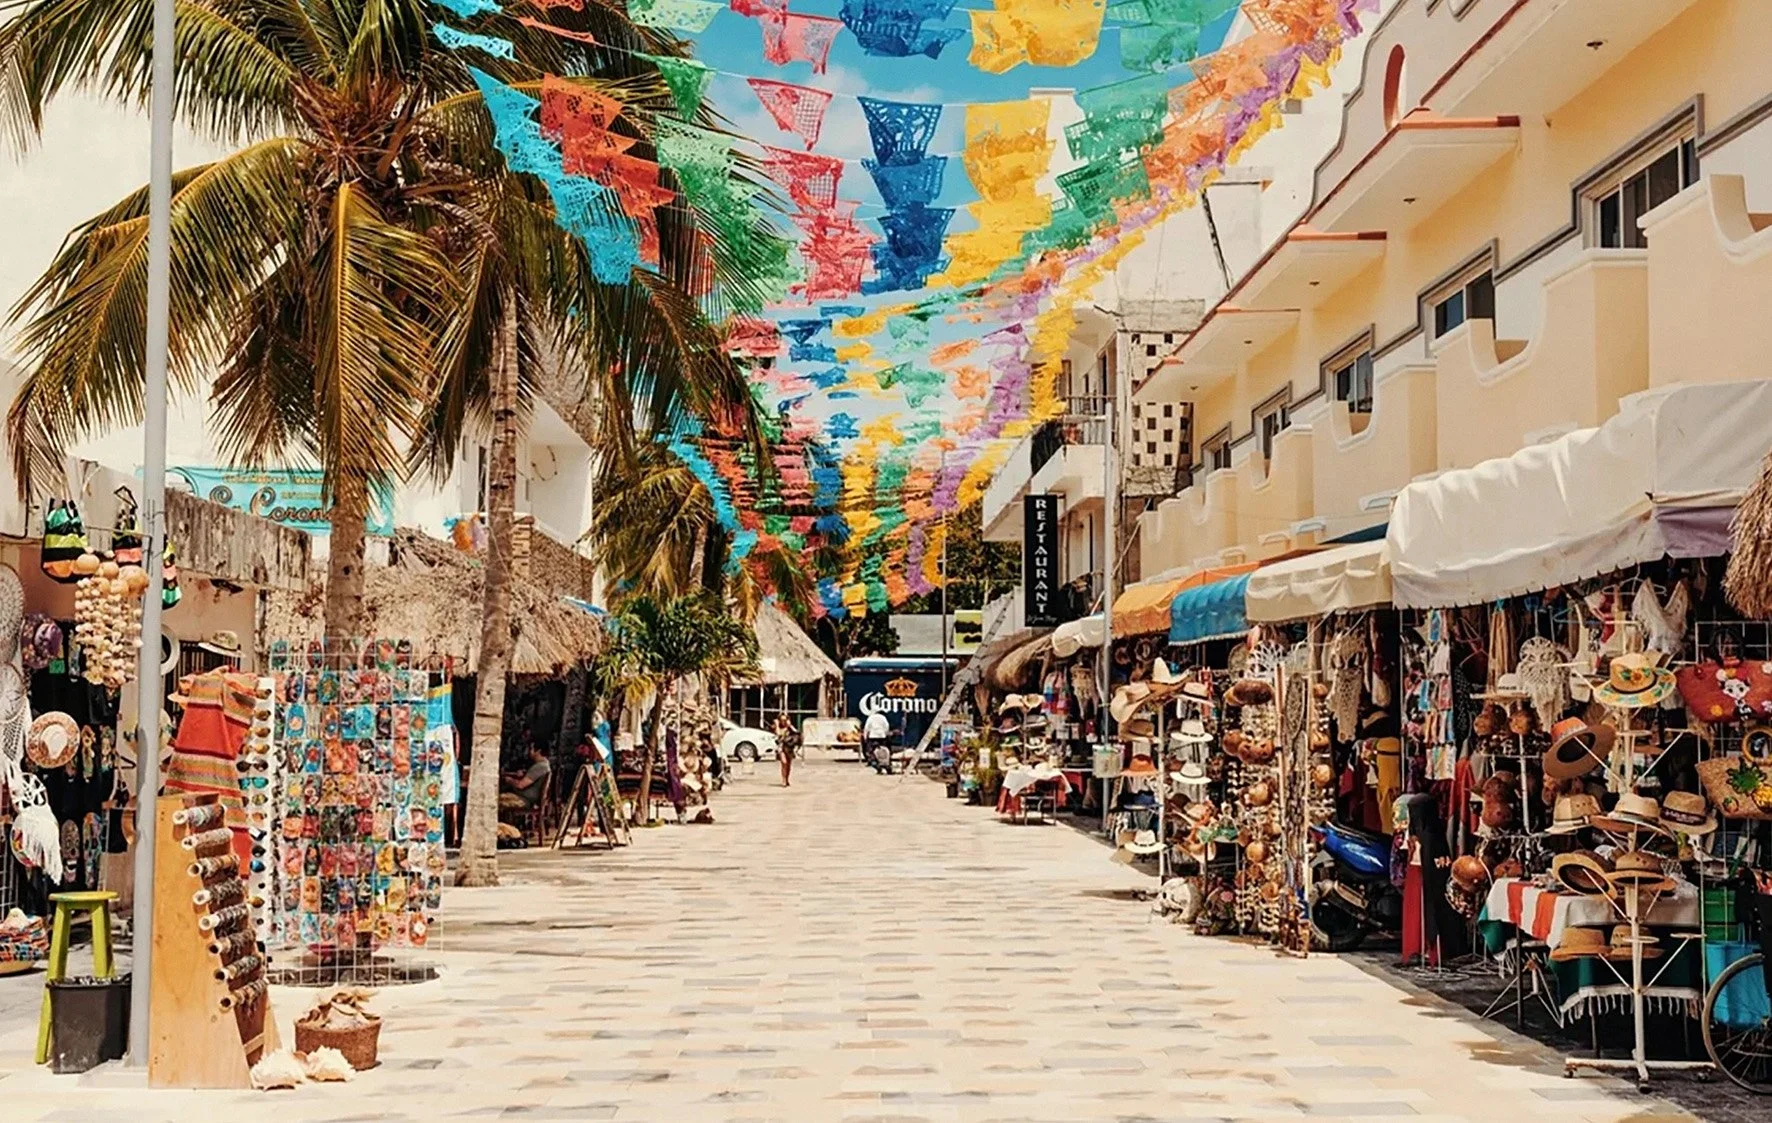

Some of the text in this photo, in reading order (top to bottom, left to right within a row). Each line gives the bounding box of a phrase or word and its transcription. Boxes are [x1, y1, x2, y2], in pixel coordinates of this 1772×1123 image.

[249, 486, 332, 522] Coron
[1034, 498, 1048, 613] RESTAURANT
[858, 691, 937, 716] Corona
